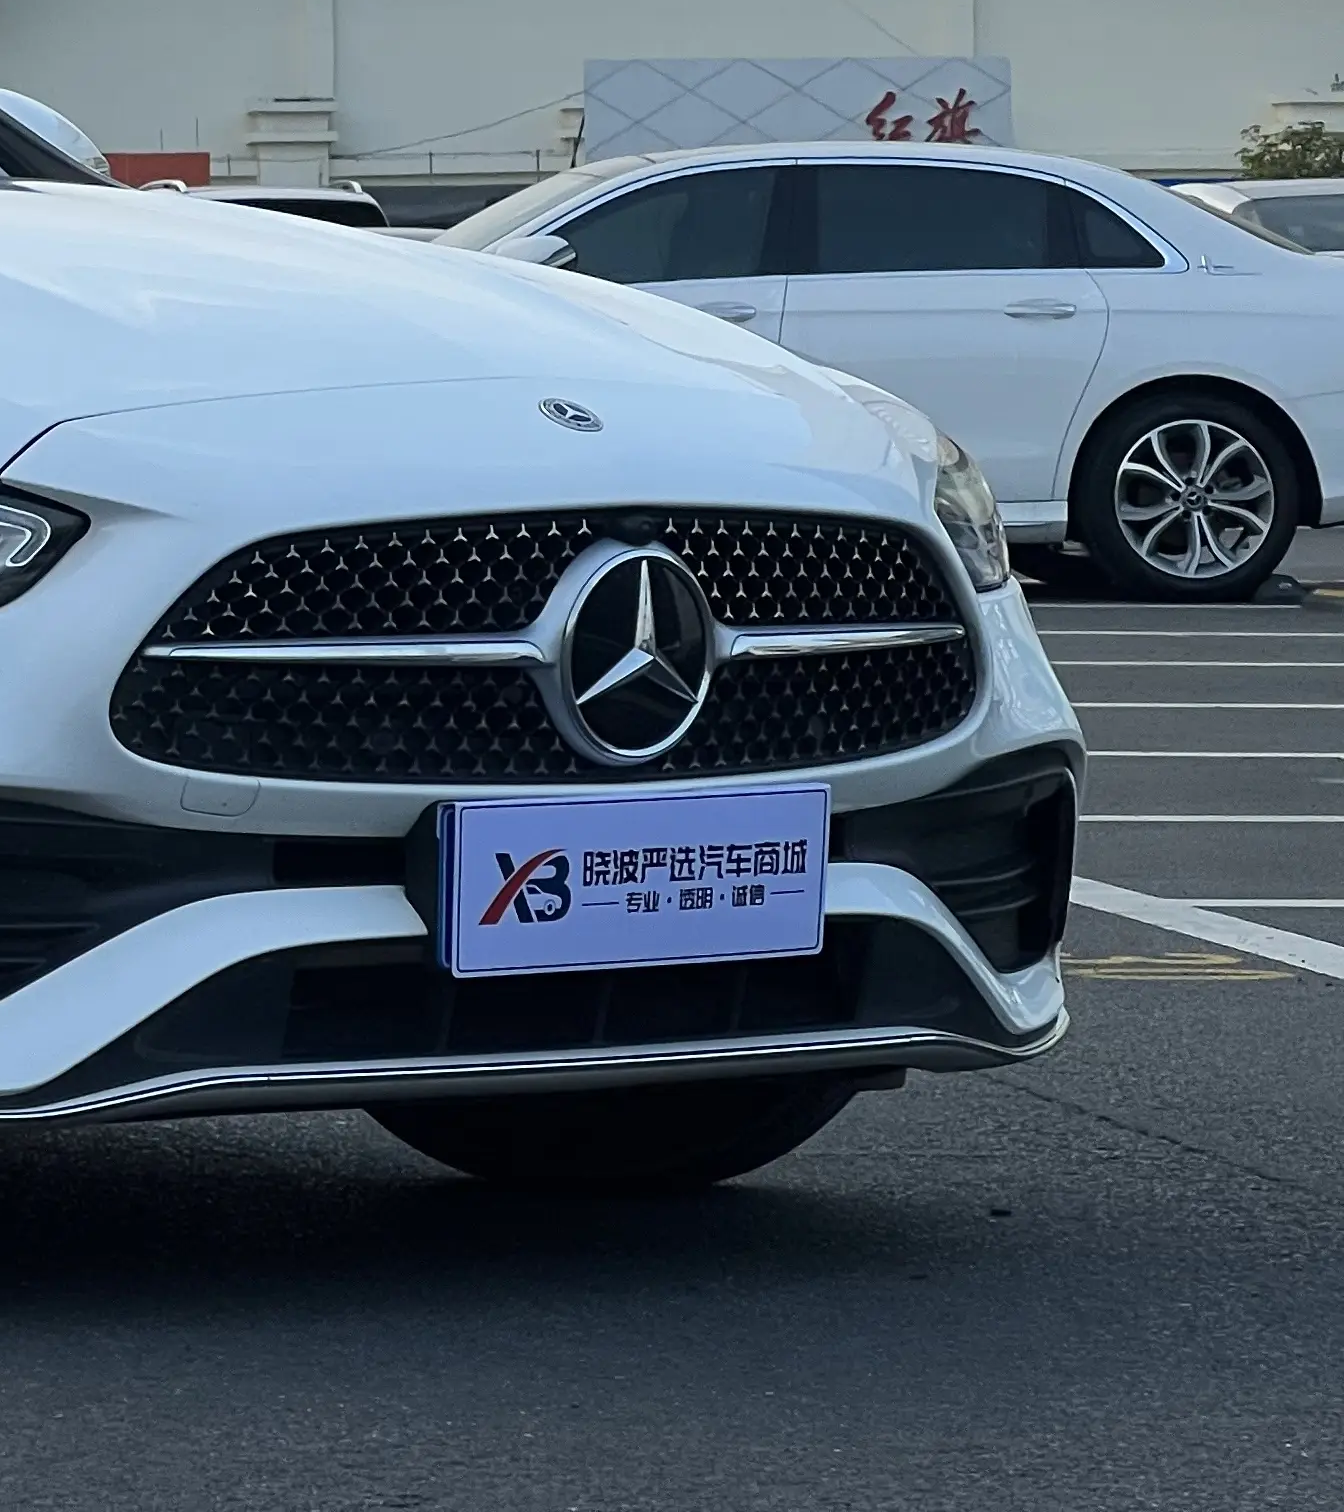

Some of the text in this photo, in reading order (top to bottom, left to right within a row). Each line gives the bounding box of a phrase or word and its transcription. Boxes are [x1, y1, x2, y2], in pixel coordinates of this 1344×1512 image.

[864, 87, 983, 144] 红旗
[582, 838, 808, 887] 晓波严选汽车商城
